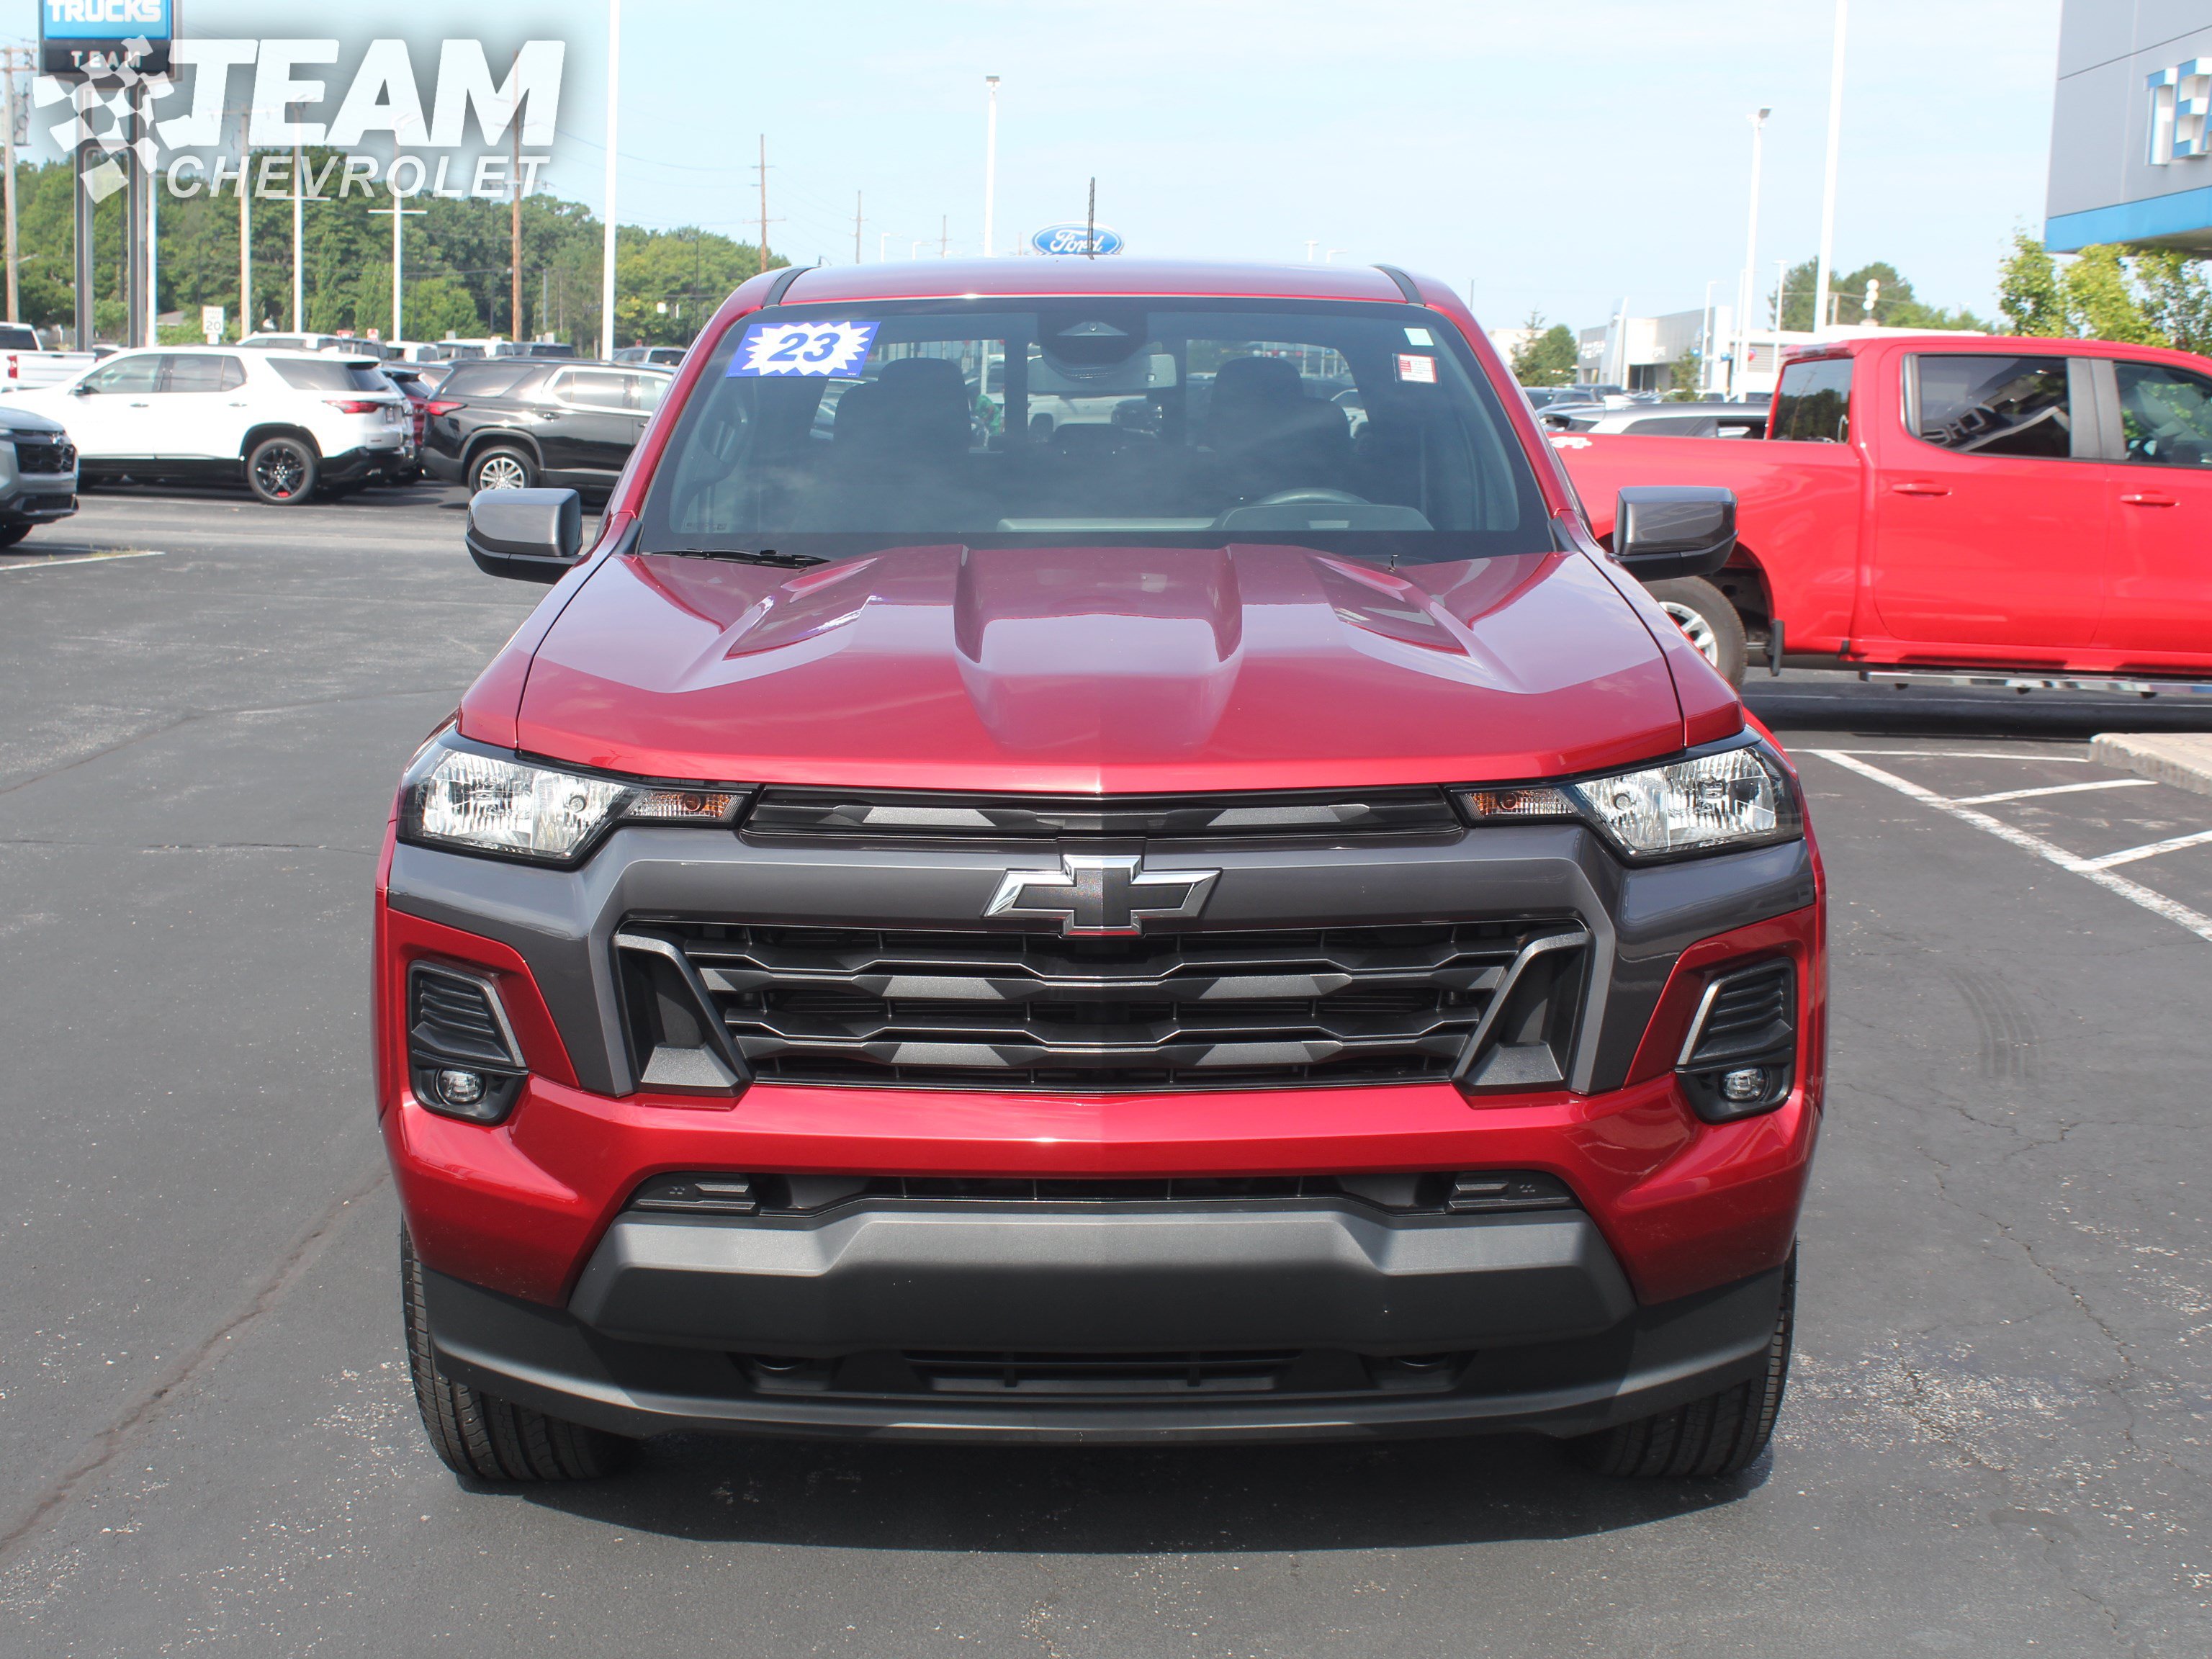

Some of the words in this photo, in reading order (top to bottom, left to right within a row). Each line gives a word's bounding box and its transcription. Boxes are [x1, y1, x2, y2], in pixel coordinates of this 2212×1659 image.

[47, 0, 161, 22] TRUCKS
[71, 50, 143, 68] TEAM
[1049, 229, 1105, 253] Ford
[206, 320, 221, 331] 20
[767, 332, 841, 362] 23
